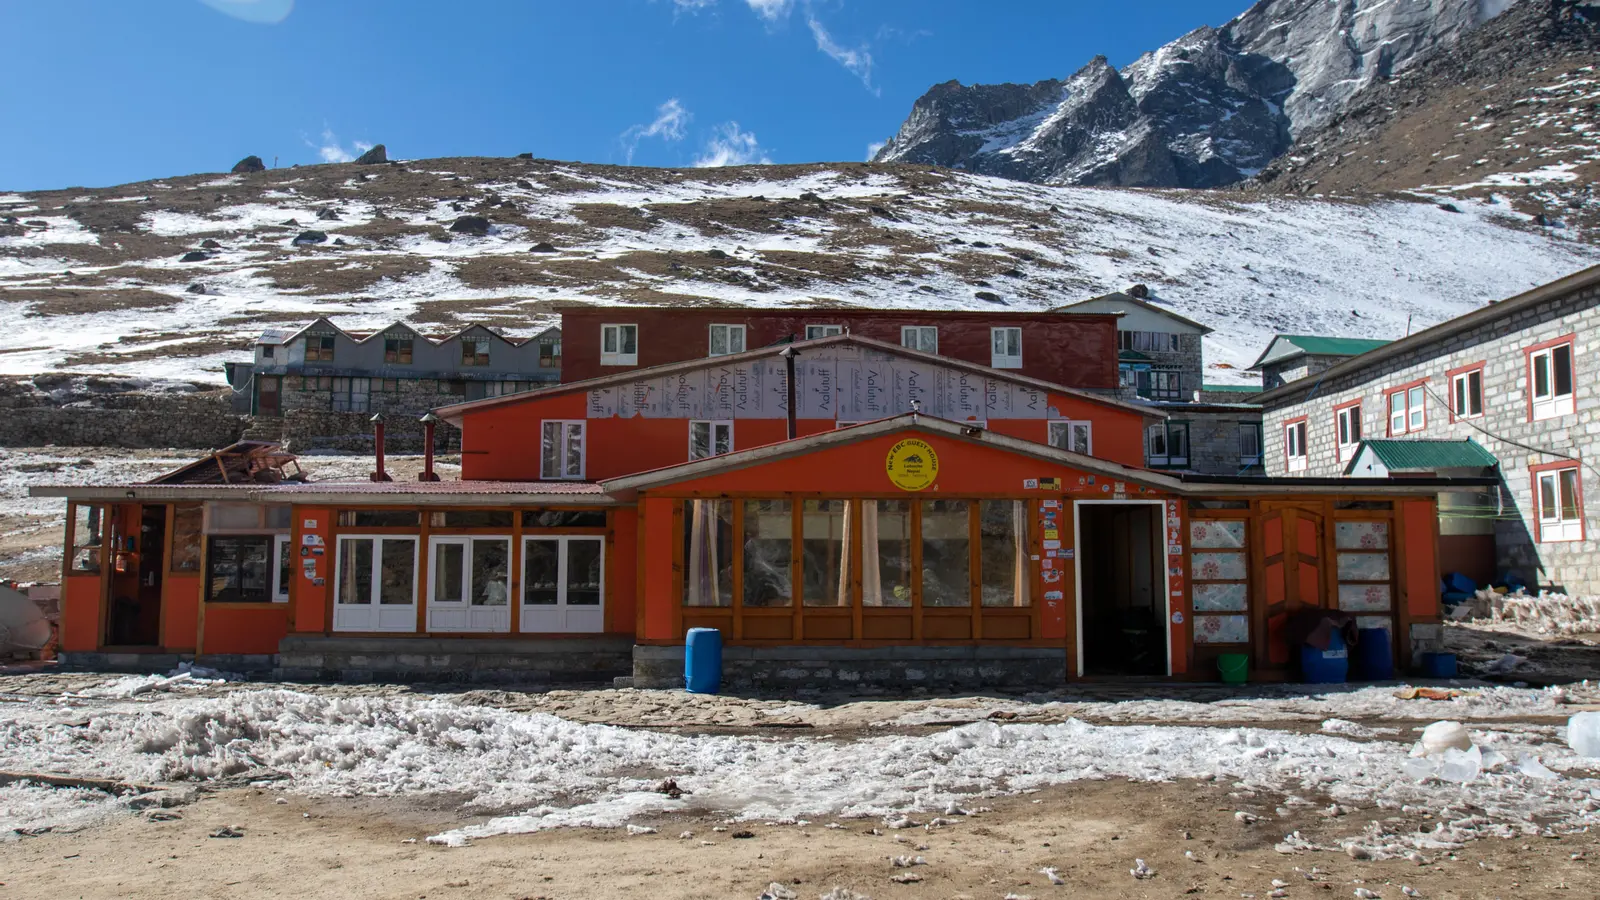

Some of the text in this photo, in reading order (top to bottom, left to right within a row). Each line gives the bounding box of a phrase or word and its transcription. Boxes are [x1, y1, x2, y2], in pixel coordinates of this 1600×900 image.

[892, 442, 906, 454] EBC
[906, 440, 927, 449] GUEST
[927, 449, 936, 470] HOUSE
